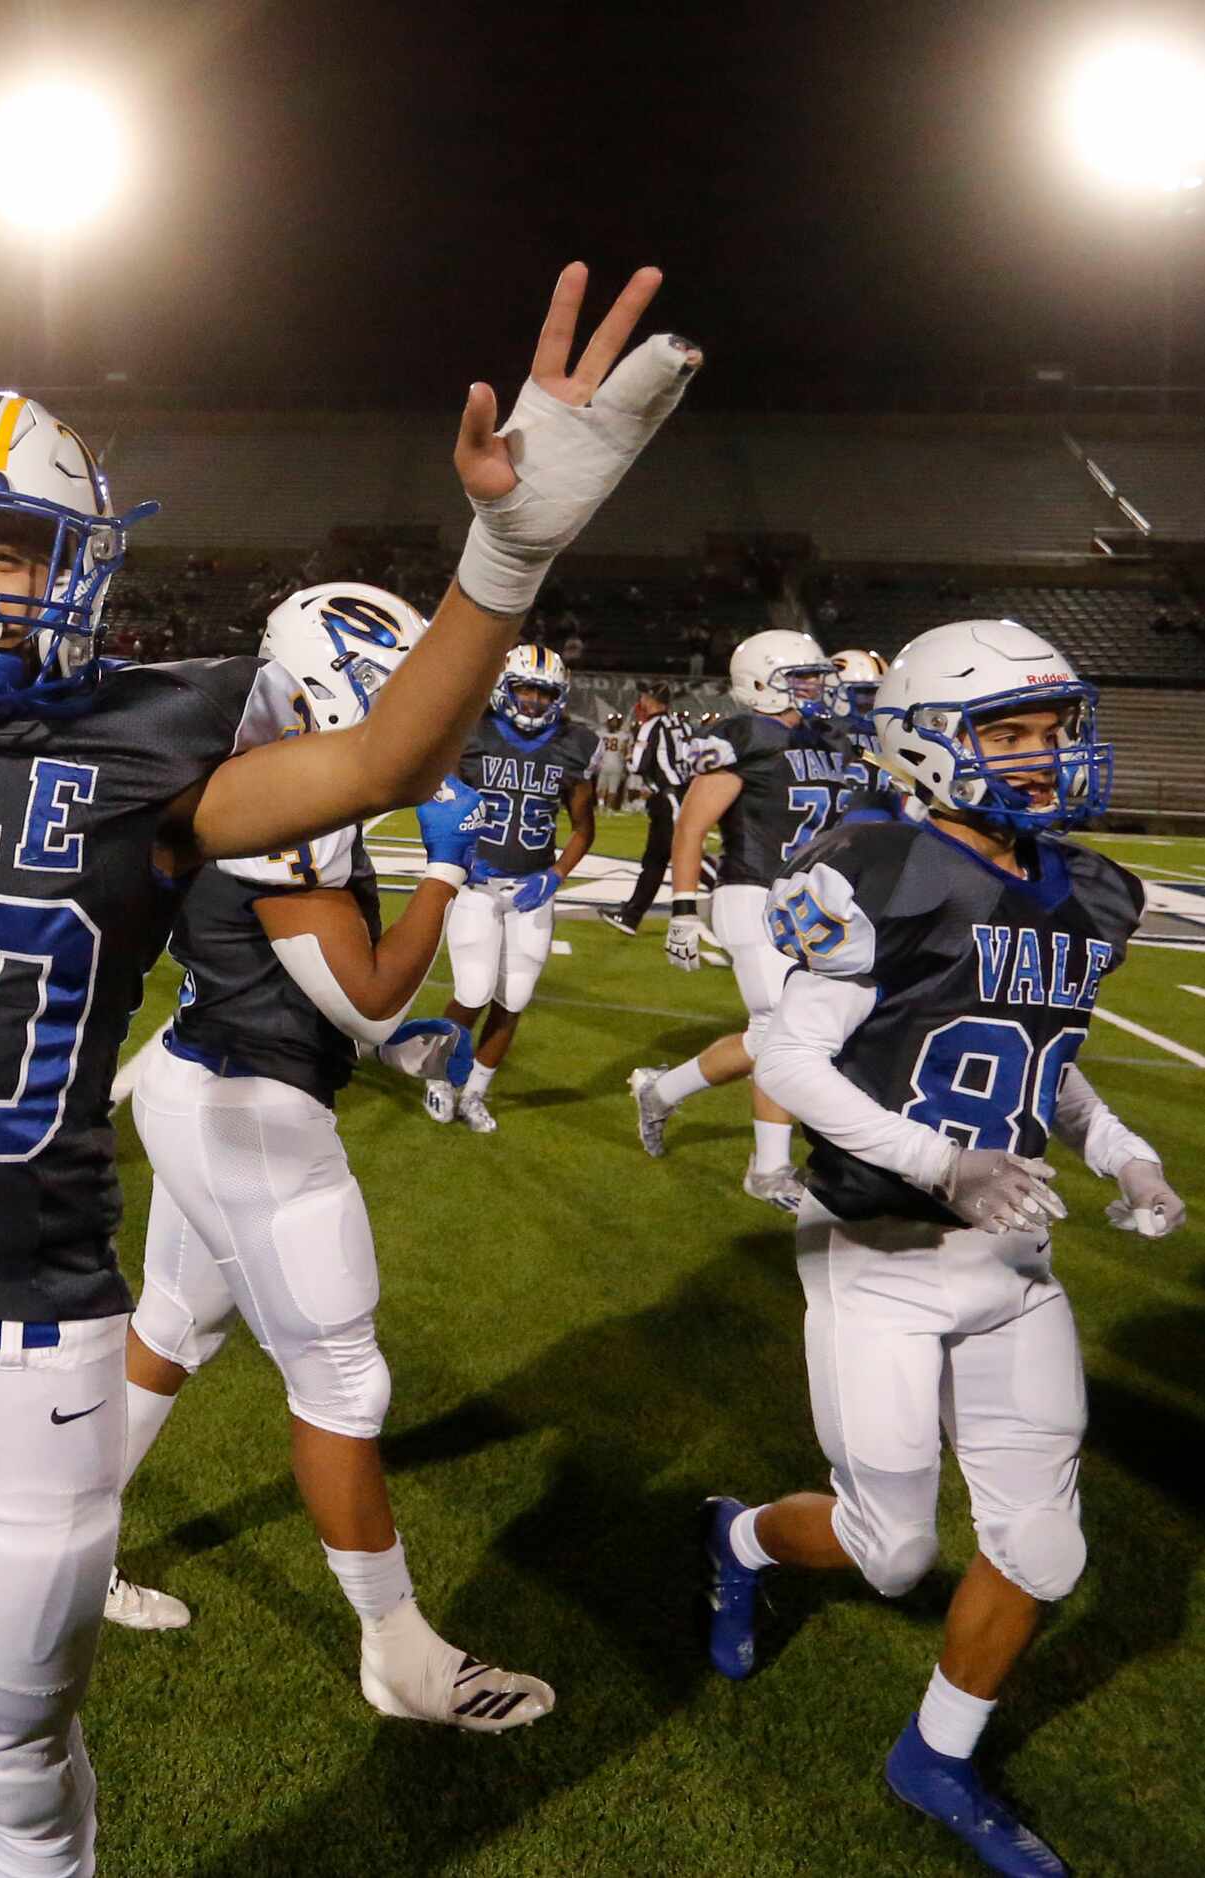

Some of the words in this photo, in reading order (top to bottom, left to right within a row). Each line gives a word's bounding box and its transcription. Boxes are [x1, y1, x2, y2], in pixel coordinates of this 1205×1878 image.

[481, 755, 564, 795] VALE
[477, 788, 558, 850] 25
[971, 924, 1113, 1012] VALE
